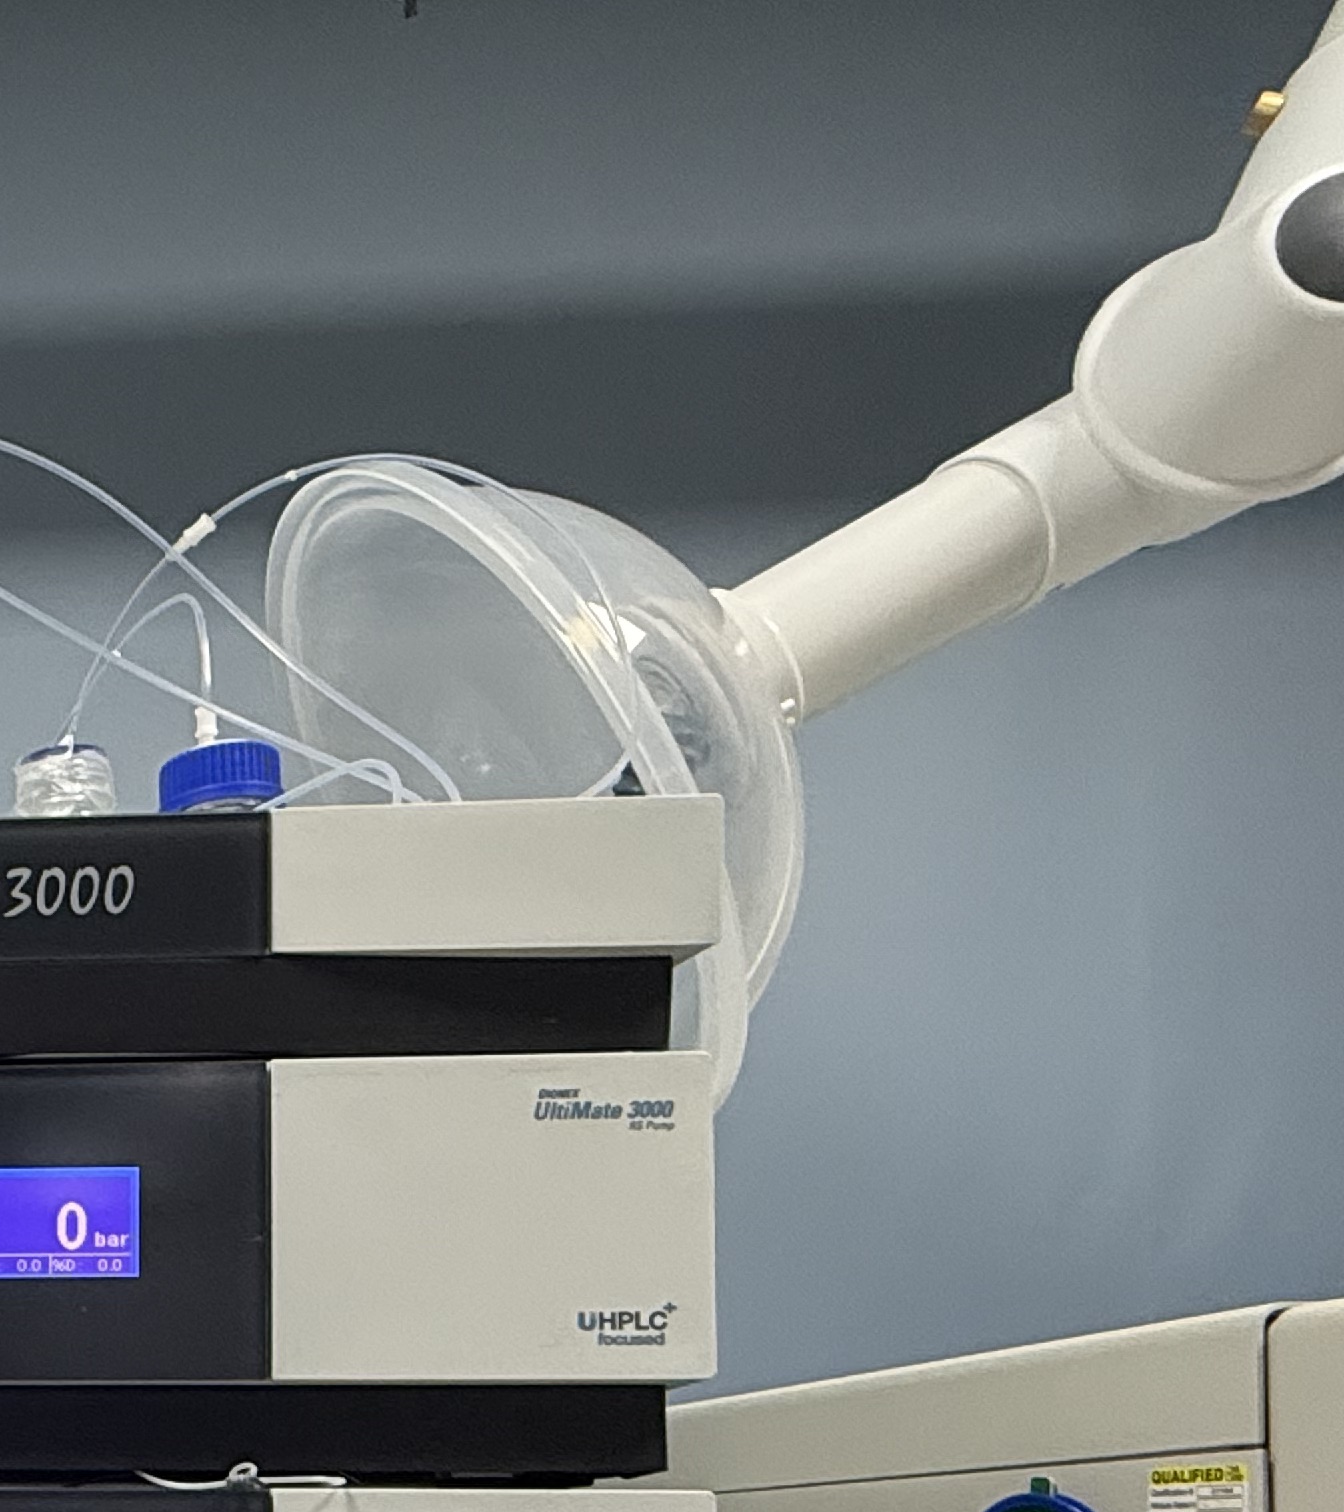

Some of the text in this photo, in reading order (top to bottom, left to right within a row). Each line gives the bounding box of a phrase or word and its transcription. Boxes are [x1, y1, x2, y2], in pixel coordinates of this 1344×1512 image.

[3, 864, 135, 918] 3000
[534, 1100, 674, 1120] UltiMate 3000
[56, 1201, 130, 1251] 0 bar
[598, 1334, 665, 1345] focused
[1151, 1468, 1224, 1484] QUALIFIED
